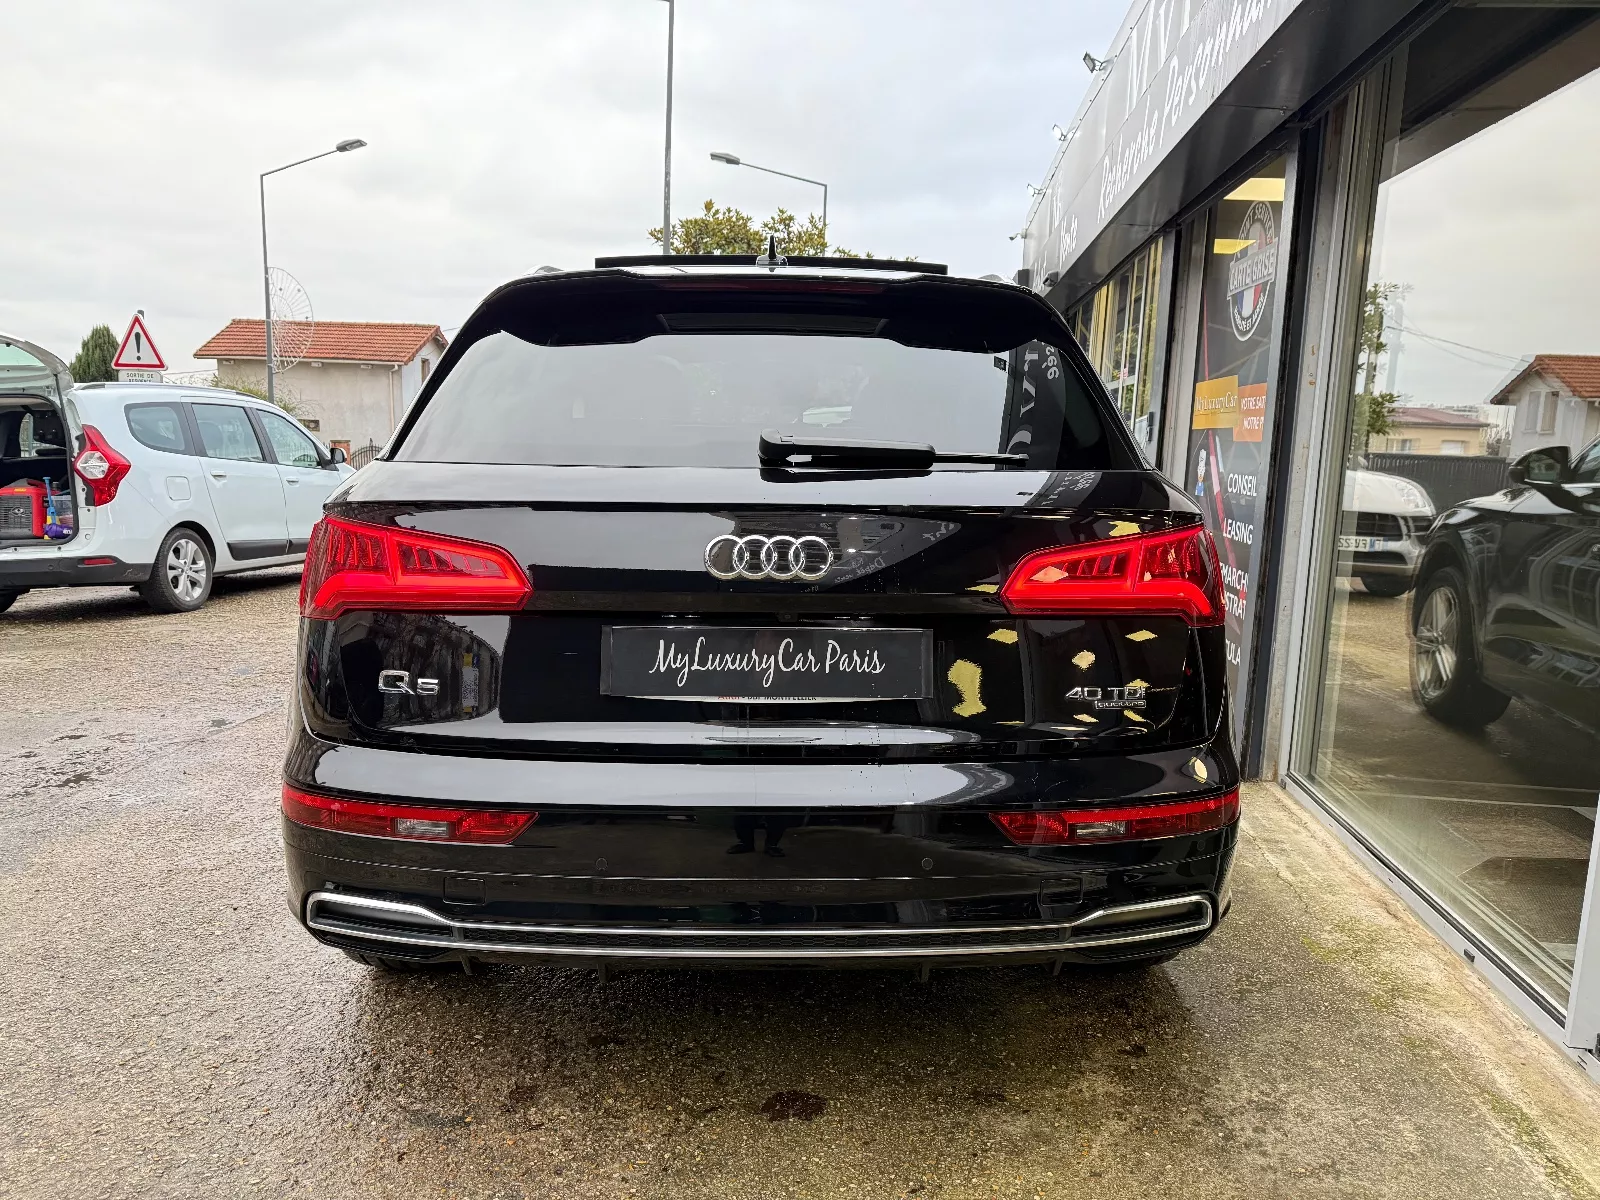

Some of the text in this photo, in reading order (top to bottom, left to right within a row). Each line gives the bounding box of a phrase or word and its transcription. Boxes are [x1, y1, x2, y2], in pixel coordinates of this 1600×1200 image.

[1229, 247, 1275, 291] CARTE GRISE
[1227, 473, 1257, 496] CONSEIL
[1222, 518, 1254, 545] LEASING
[825, 639, 886, 674] Paris
[378, 669, 440, 696] Q5
[1064, 686, 1146, 701] 40 TDI
